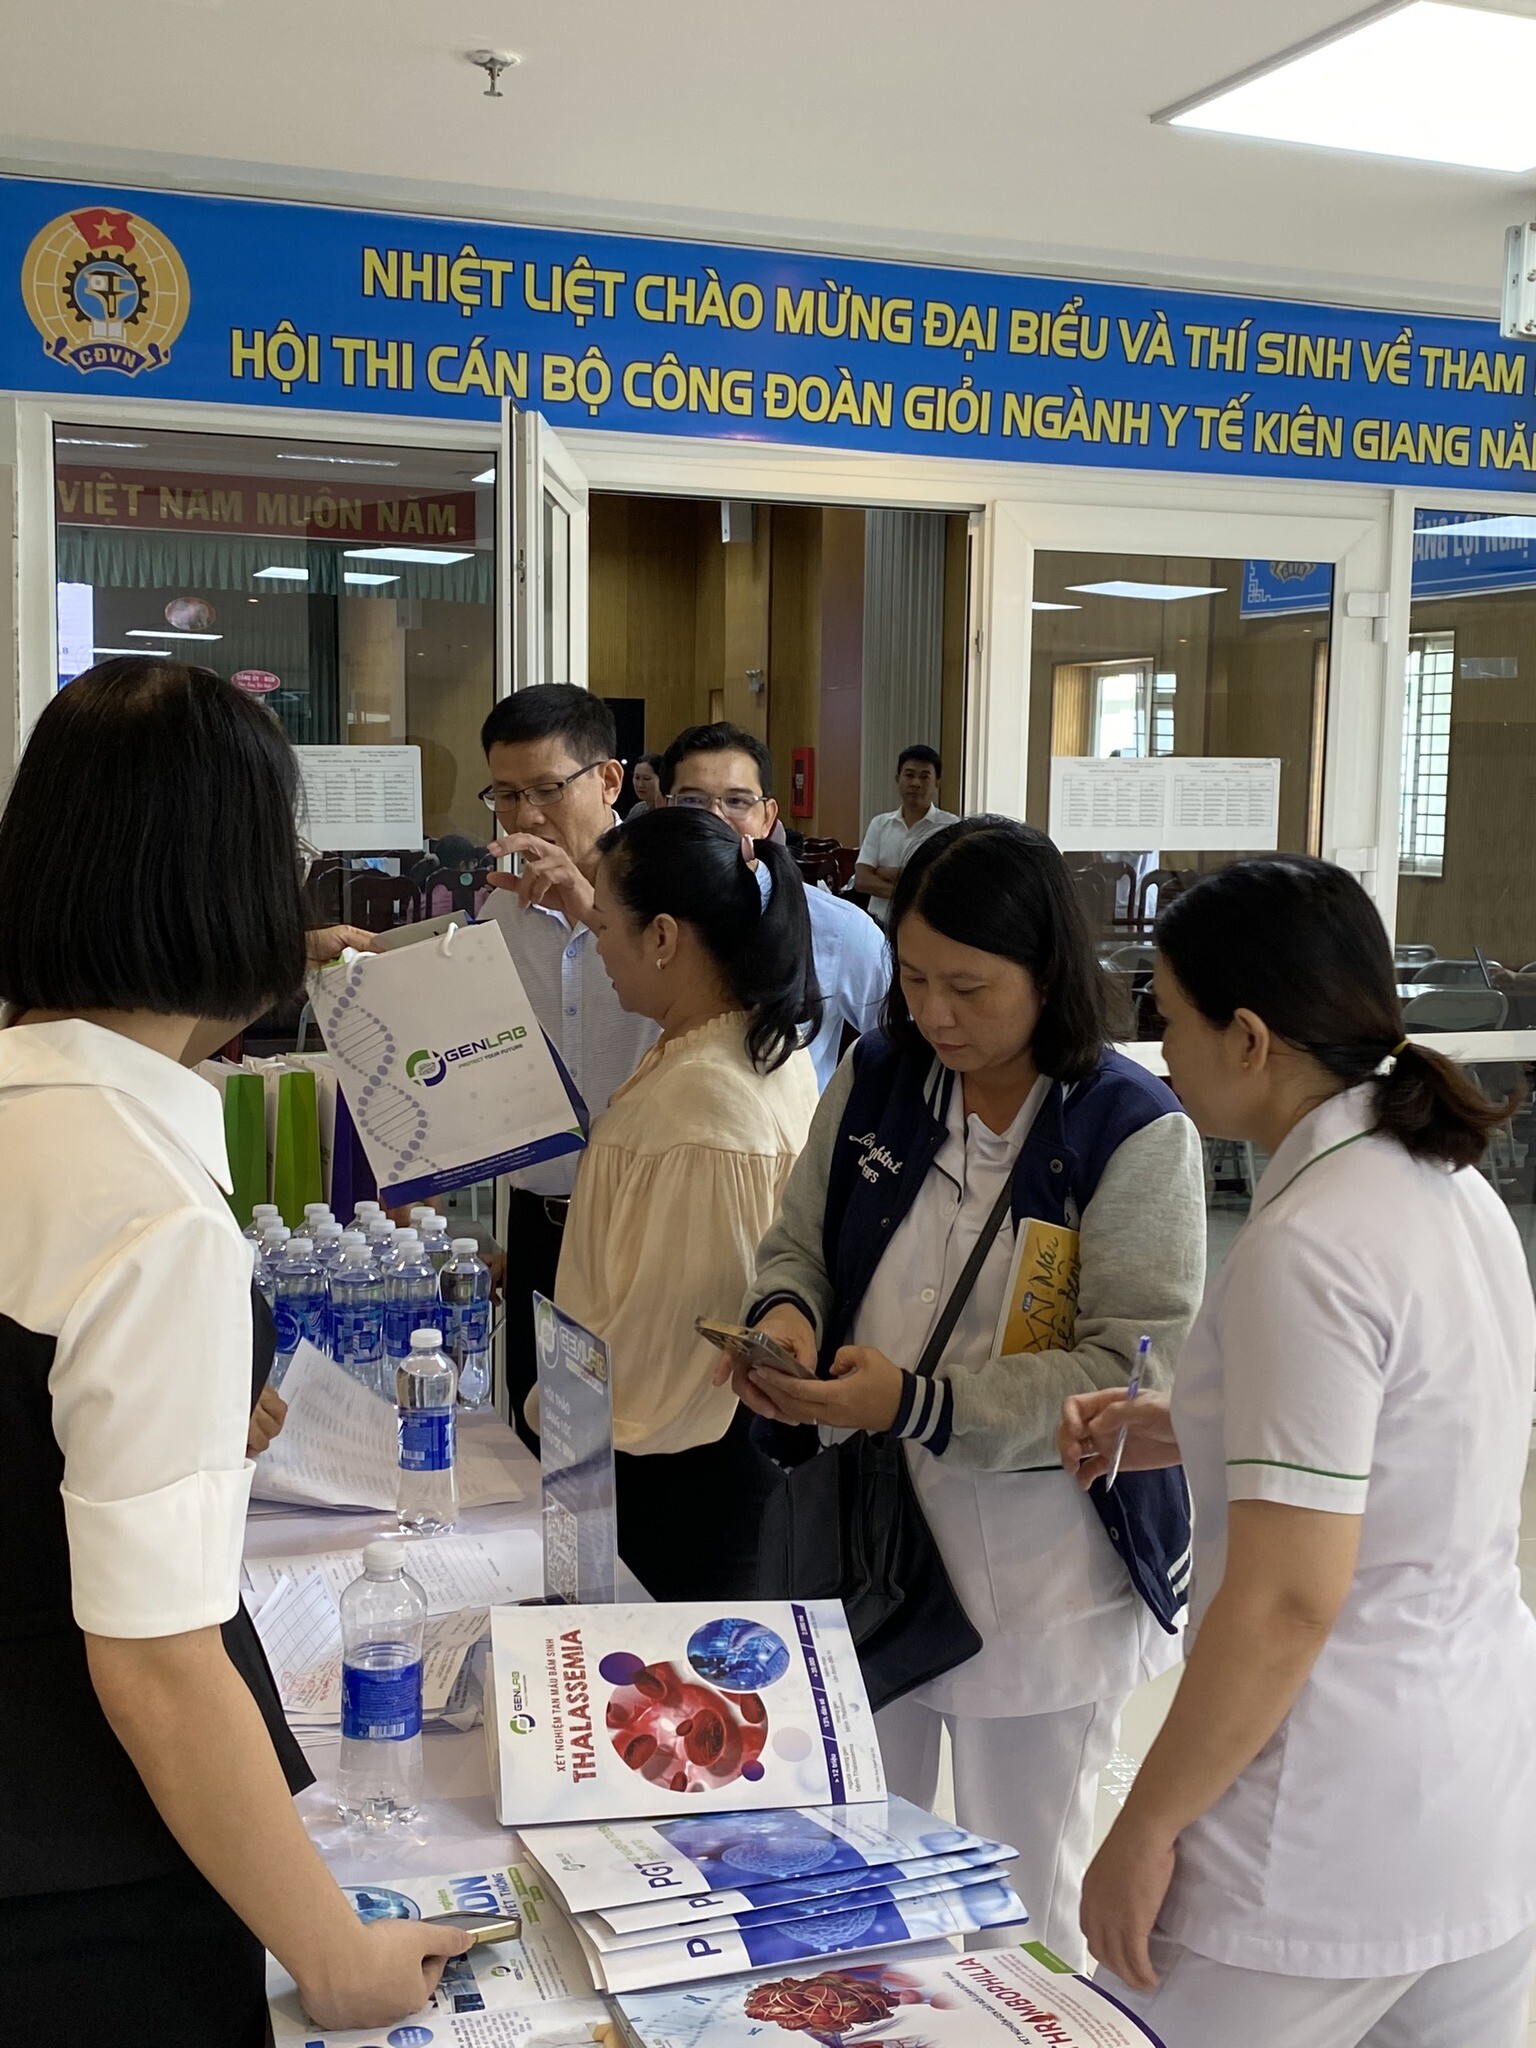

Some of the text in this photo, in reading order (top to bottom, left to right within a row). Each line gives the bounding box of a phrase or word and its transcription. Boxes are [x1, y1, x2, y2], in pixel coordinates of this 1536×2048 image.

[362, 244, 1526, 395] NHIỆT LIỆT CHÀO MỪNG ĐẠI BIỂU VÀ THÍ SINH VỀ THAM
[80, 347, 136, 368] CĐVN
[230, 319, 1536, 471] HỘI THI CÁN BỘ CÔNG ĐOÀN GIỎI NGÀNH Y TẾ KIÊN GIANG NĂ
[57, 472, 457, 536] VIỆT NAM MUÔN NĂM
[444, 1026, 528, 1062] GENLAB
[484, 1050, 501, 1060] YOUR
[501, 1043, 523, 1055] FUTURE
[545, 1638, 555, 1657] SINH
[511, 1671, 523, 1711] GENLAB
[549, 1671, 560, 1695] MÁU
[551, 1695, 562, 1714] TAN
[560, 1629, 597, 1784] THALASSEMIA
[551, 1716, 565, 1752] NGHIỆM
[556, 1754, 566, 1773] XÉT
[634, 1861, 682, 1889] PGT
